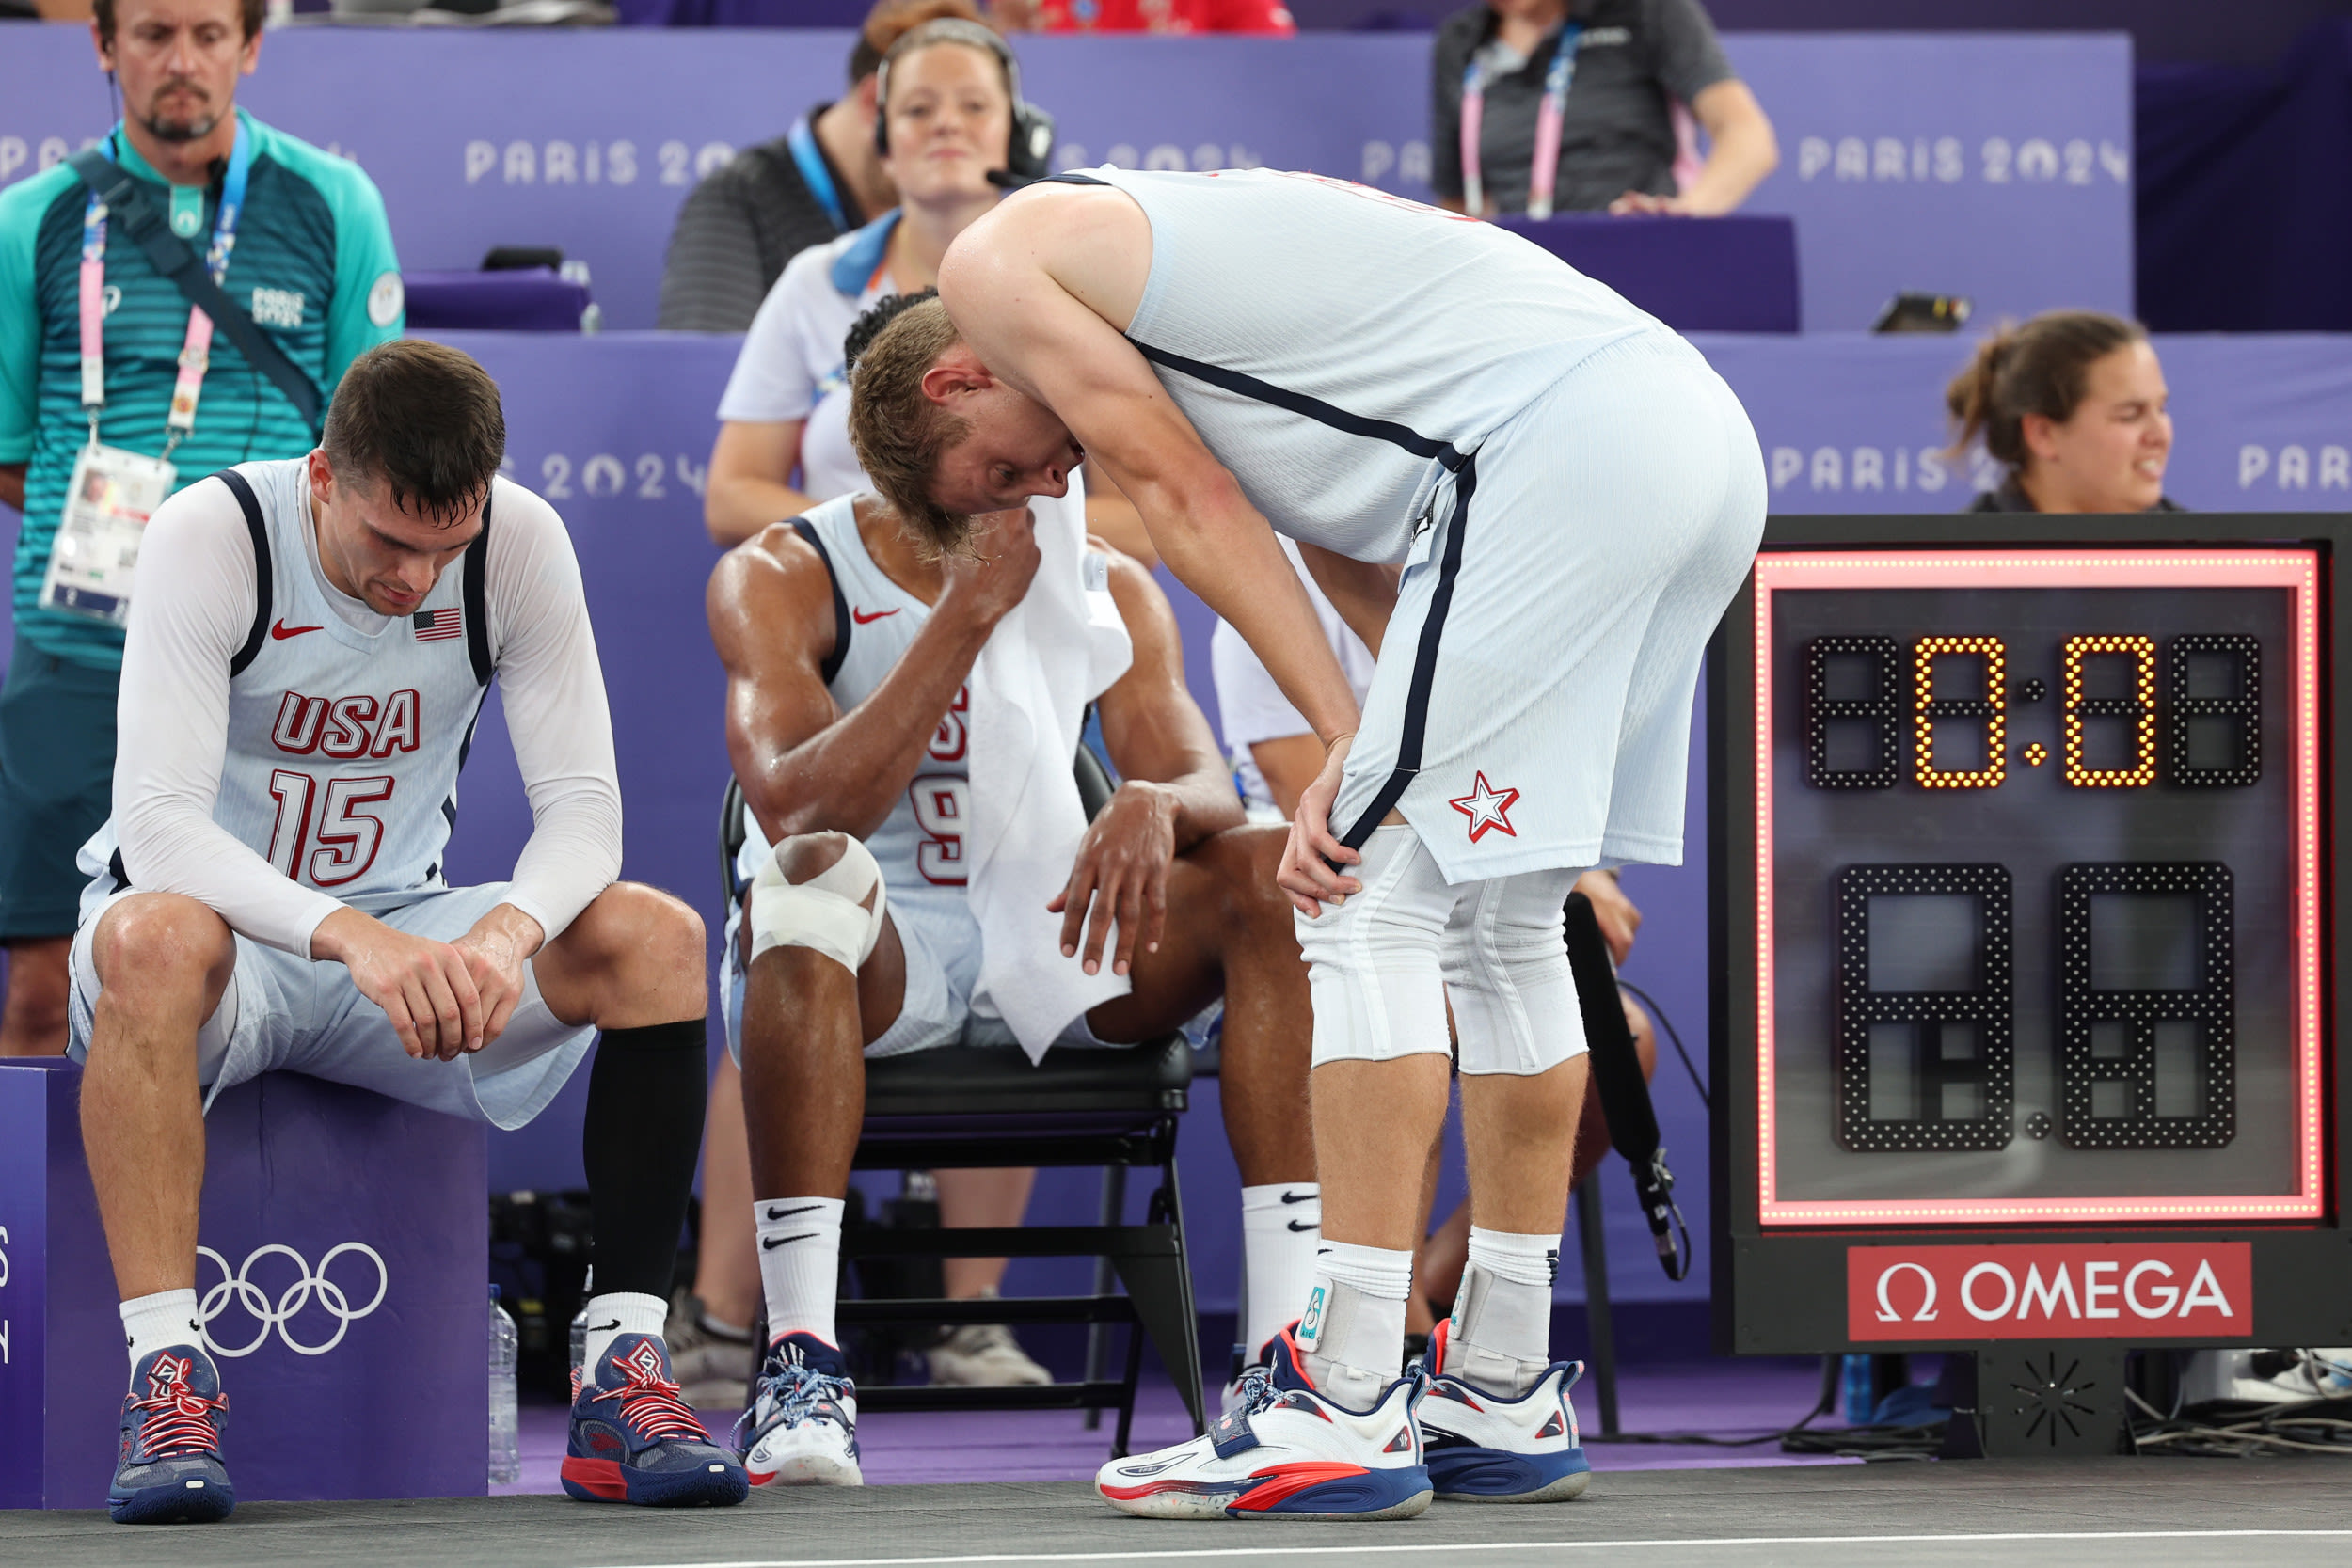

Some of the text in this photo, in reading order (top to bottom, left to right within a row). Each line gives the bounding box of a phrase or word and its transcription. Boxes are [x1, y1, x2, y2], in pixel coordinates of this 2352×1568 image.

[465, 139, 737, 185] PARIS 20
[1798, 137, 2129, 186] PARIS 2024
[541, 452, 707, 501] 2024
[1772, 446, 1948, 494] PARIS
[2238, 443, 2352, 492] PAR
[271, 689, 420, 758] USA
[267, 768, 396, 887] 15
[1960, 1259, 2233, 1321] OMEGA
